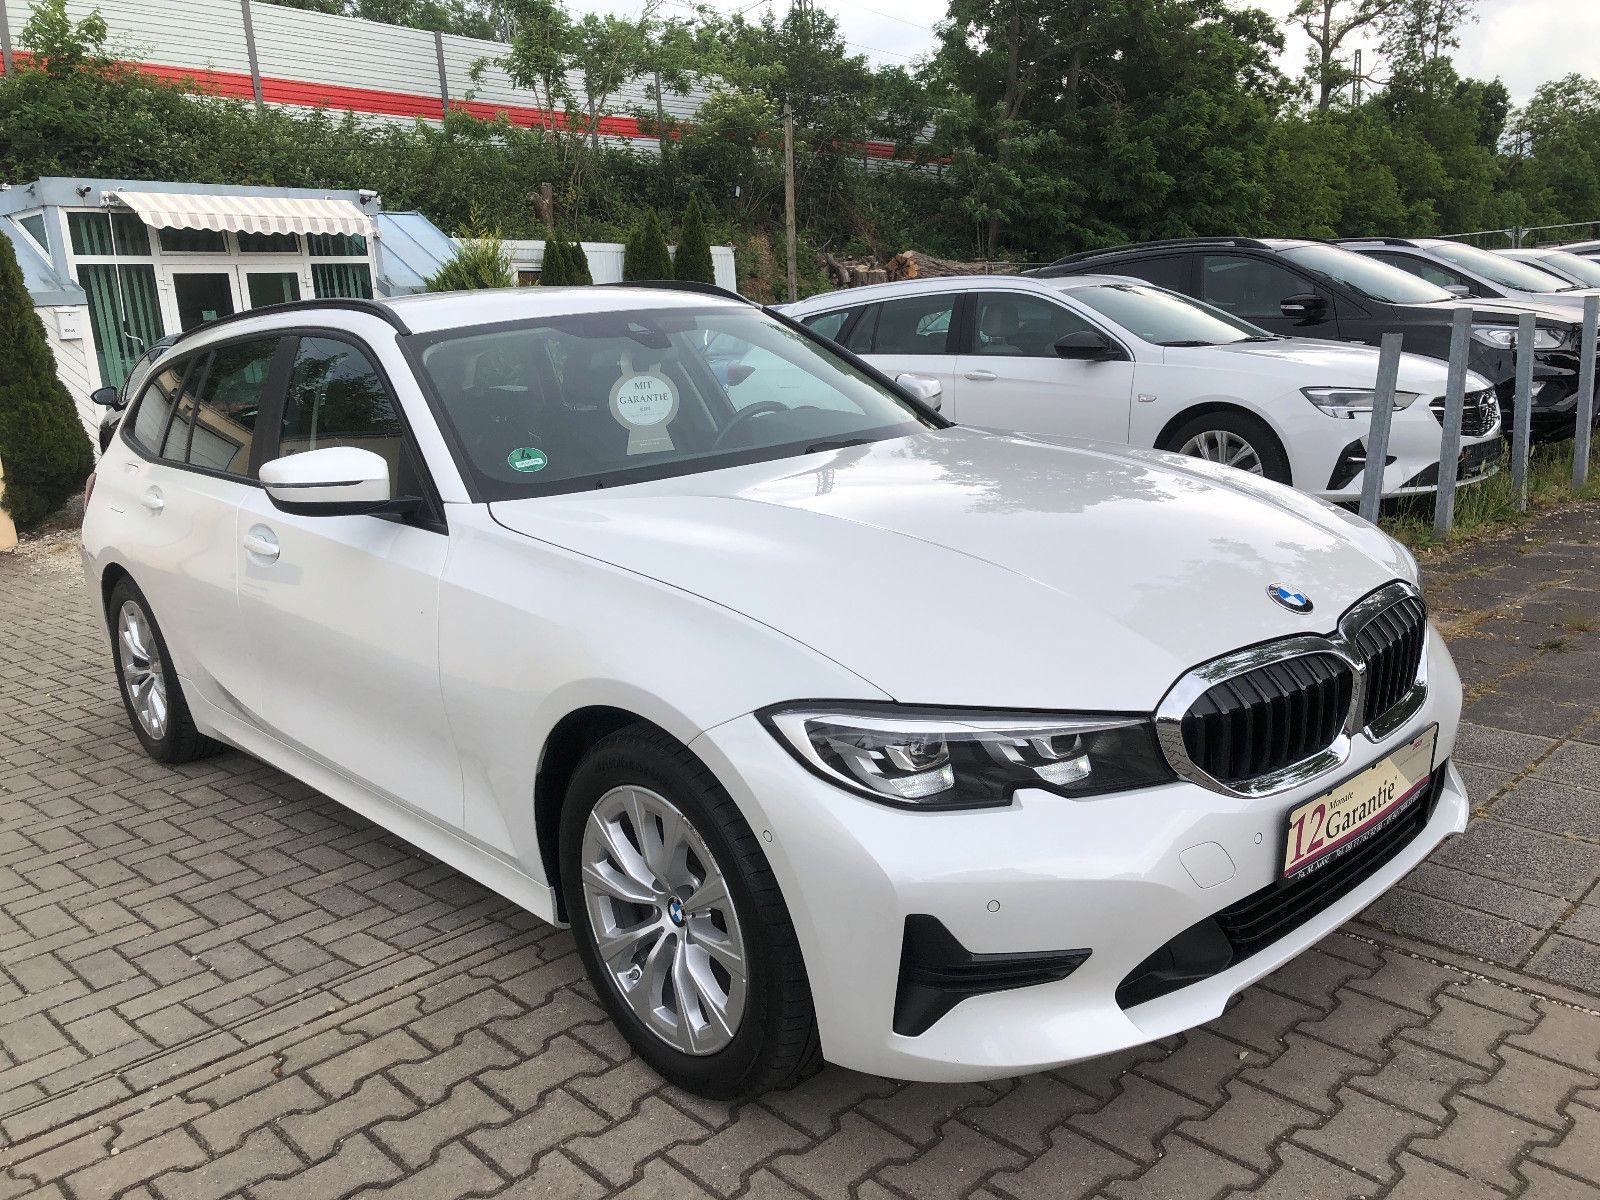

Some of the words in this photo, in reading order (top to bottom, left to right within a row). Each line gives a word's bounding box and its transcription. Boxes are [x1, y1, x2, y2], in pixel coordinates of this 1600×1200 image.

[634, 381, 653, 390] MIT
[619, 393, 669, 405] GARANTIE
[1328, 791, 1354, 811] Monate
[1290, 803, 1326, 865] 12
